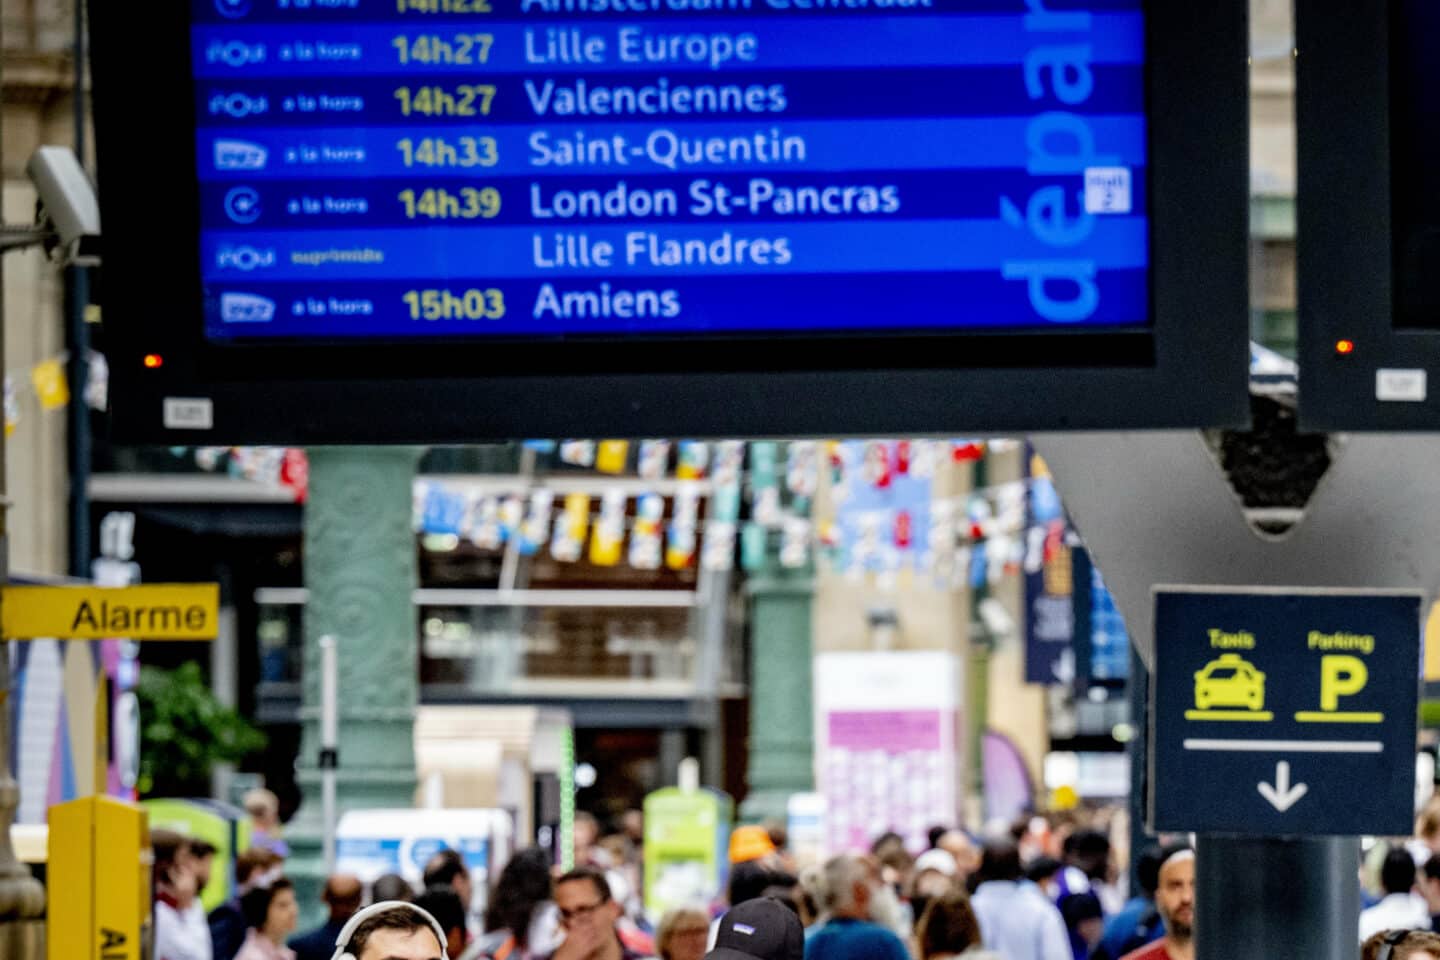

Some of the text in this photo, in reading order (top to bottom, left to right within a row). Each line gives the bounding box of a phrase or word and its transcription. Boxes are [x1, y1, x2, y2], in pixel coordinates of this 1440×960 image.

[392, 33, 494, 65] 14h27
[524, 26, 758, 70] Lille Europe
[394, 84, 496, 116] 14h27
[523, 76, 788, 116] Valenciennes
[397, 136, 498, 167] 14h33
[528, 127, 806, 170] Saint-Quentin
[398, 188, 502, 219] 14h39
[531, 179, 899, 217] London St-Pancras
[532, 231, 792, 268] Lille Flandres
[403, 289, 505, 320] 15h03
[532, 283, 681, 319] Amiens
[72, 600, 207, 631] Alarme
[1207, 628, 1255, 649] Taxis
[1307, 630, 1376, 654] Parking
